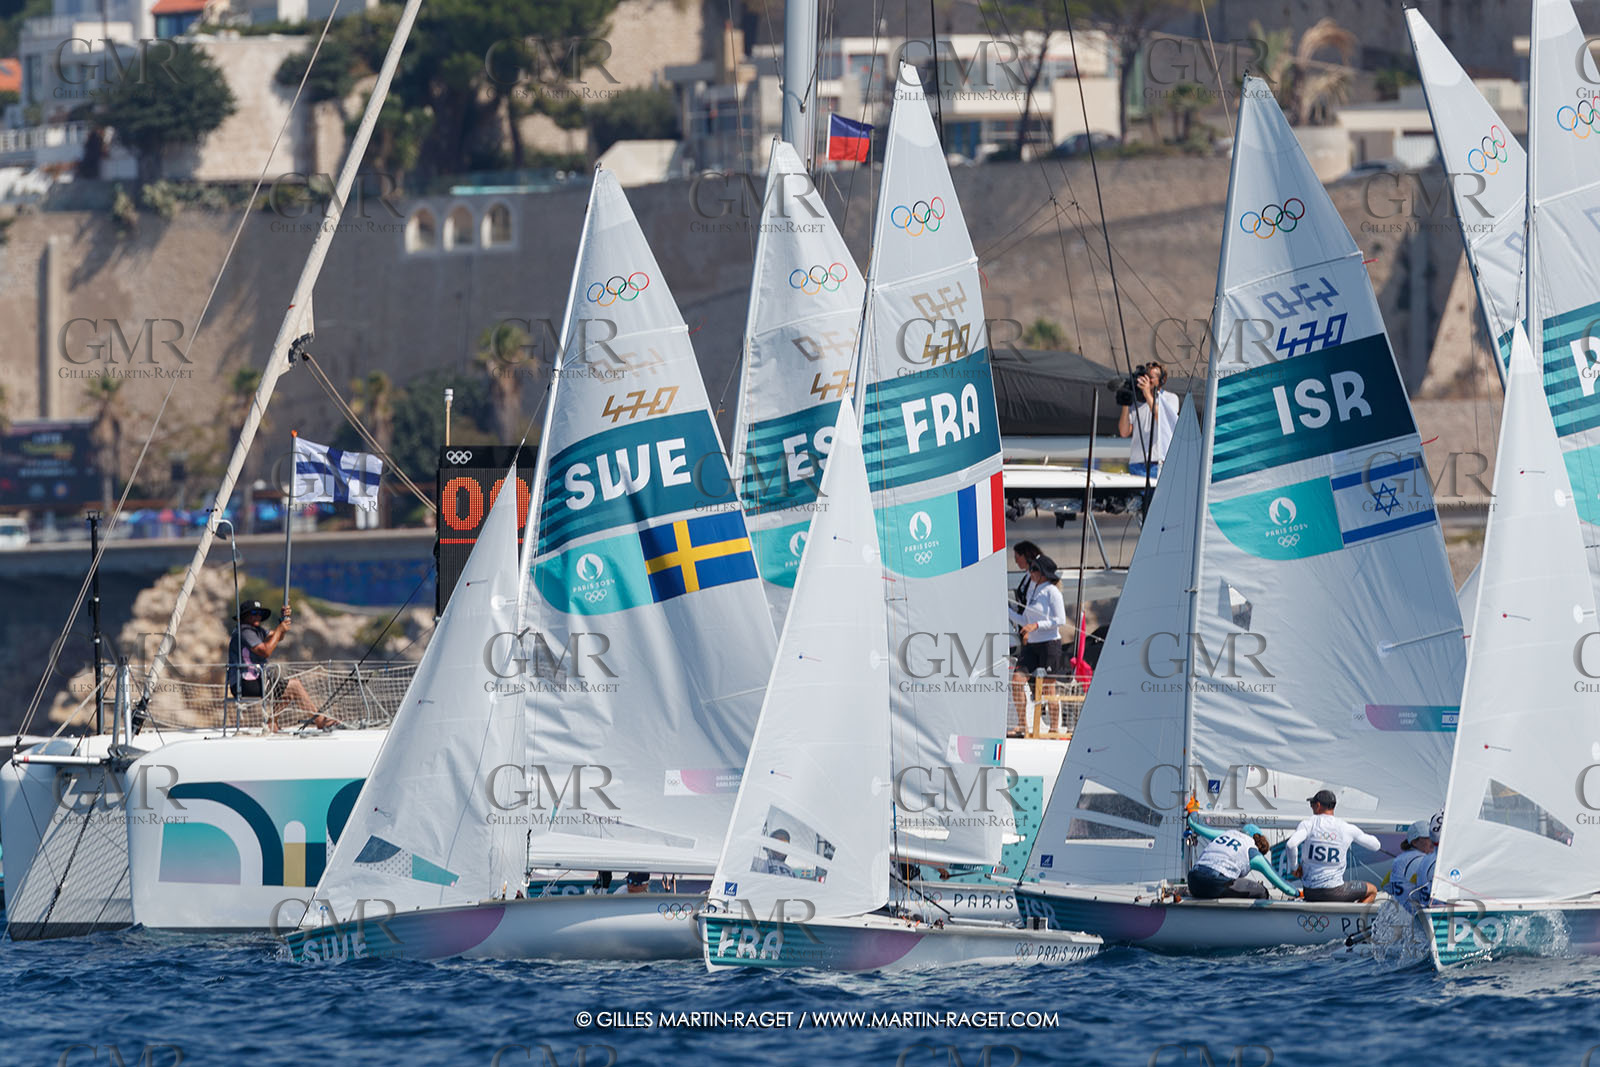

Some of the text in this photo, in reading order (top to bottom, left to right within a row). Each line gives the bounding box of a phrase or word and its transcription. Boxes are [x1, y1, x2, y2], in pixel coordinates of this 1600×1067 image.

[922, 323, 971, 366] 470
[1276, 312, 1348, 358] 470
[810, 370, 857, 400] 47
[1272, 370, 1373, 436] ISR
[601, 386, 680, 423] 470
[901, 383, 981, 454] FRA
[783, 426, 838, 483] ES
[564, 437, 692, 511] SWE
[1215, 835, 1242, 852] SR
[1308, 844, 1340, 864] ISR
[953, 893, 1014, 909] PARIS
[717, 925, 784, 960] FRA
[1036, 944, 1067, 961] PARIS
